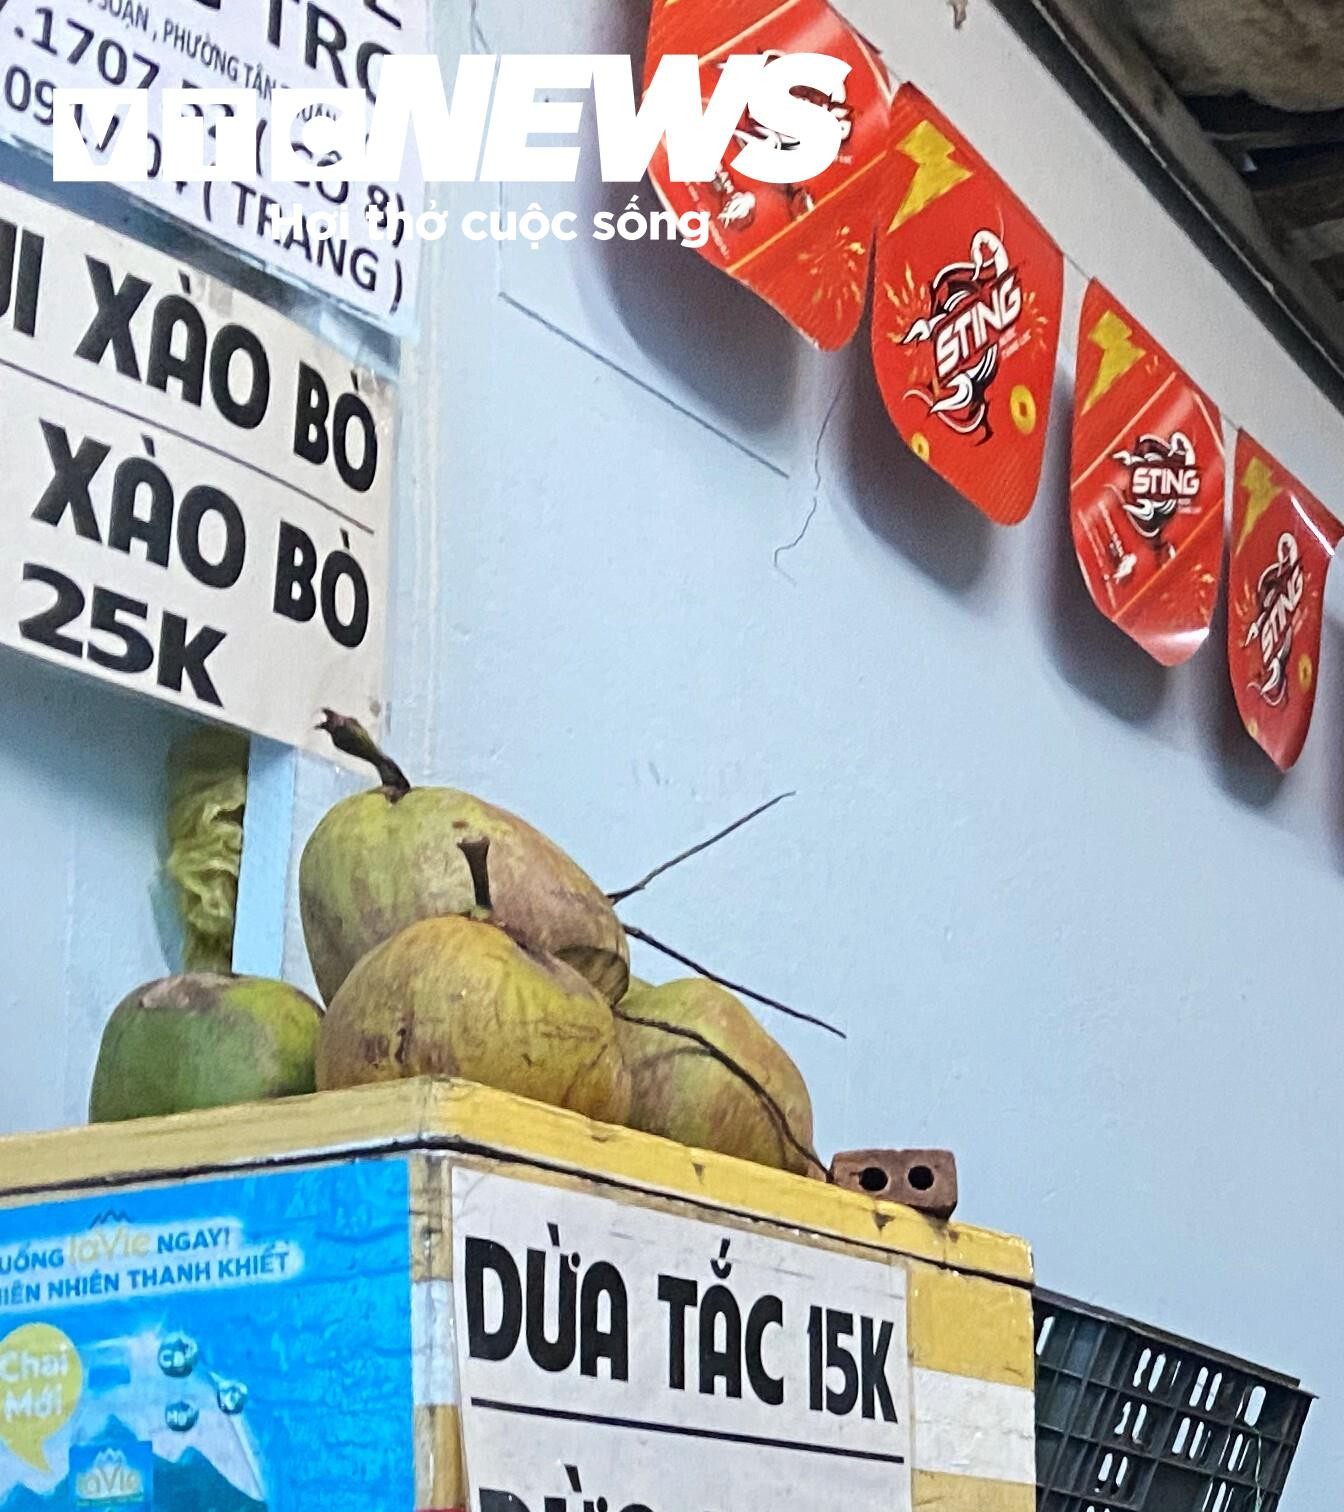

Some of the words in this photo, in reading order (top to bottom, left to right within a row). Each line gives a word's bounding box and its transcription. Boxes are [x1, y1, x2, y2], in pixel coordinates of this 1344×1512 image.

[162, 16, 239, 82] PHƯỜNG
[935, 280, 1023, 378] STING
[75, 253, 271, 430] XÀO
[293, 359, 378, 494] BÒ
[1131, 466, 1200, 495] STING
[30, 418, 247, 590] XÀO
[273, 519, 370, 649] BÒ
[18, 562, 228, 708] 25K
[1261, 563, 1304, 665] STING
[47, 1268, 120, 1299] NHIÊN
[127, 1260, 211, 1290] THANH
[218, 1240, 291, 1280] KHIẾT
[157, 1227, 231, 1254] NGAY!
[0, 1343, 69, 1383] Chai
[464, 1221, 630, 1383] DỪA
[657, 1238, 785, 1406] TẮC
[806, 1304, 899, 1425] 15K
[4, 1382, 64, 1423] Mới
